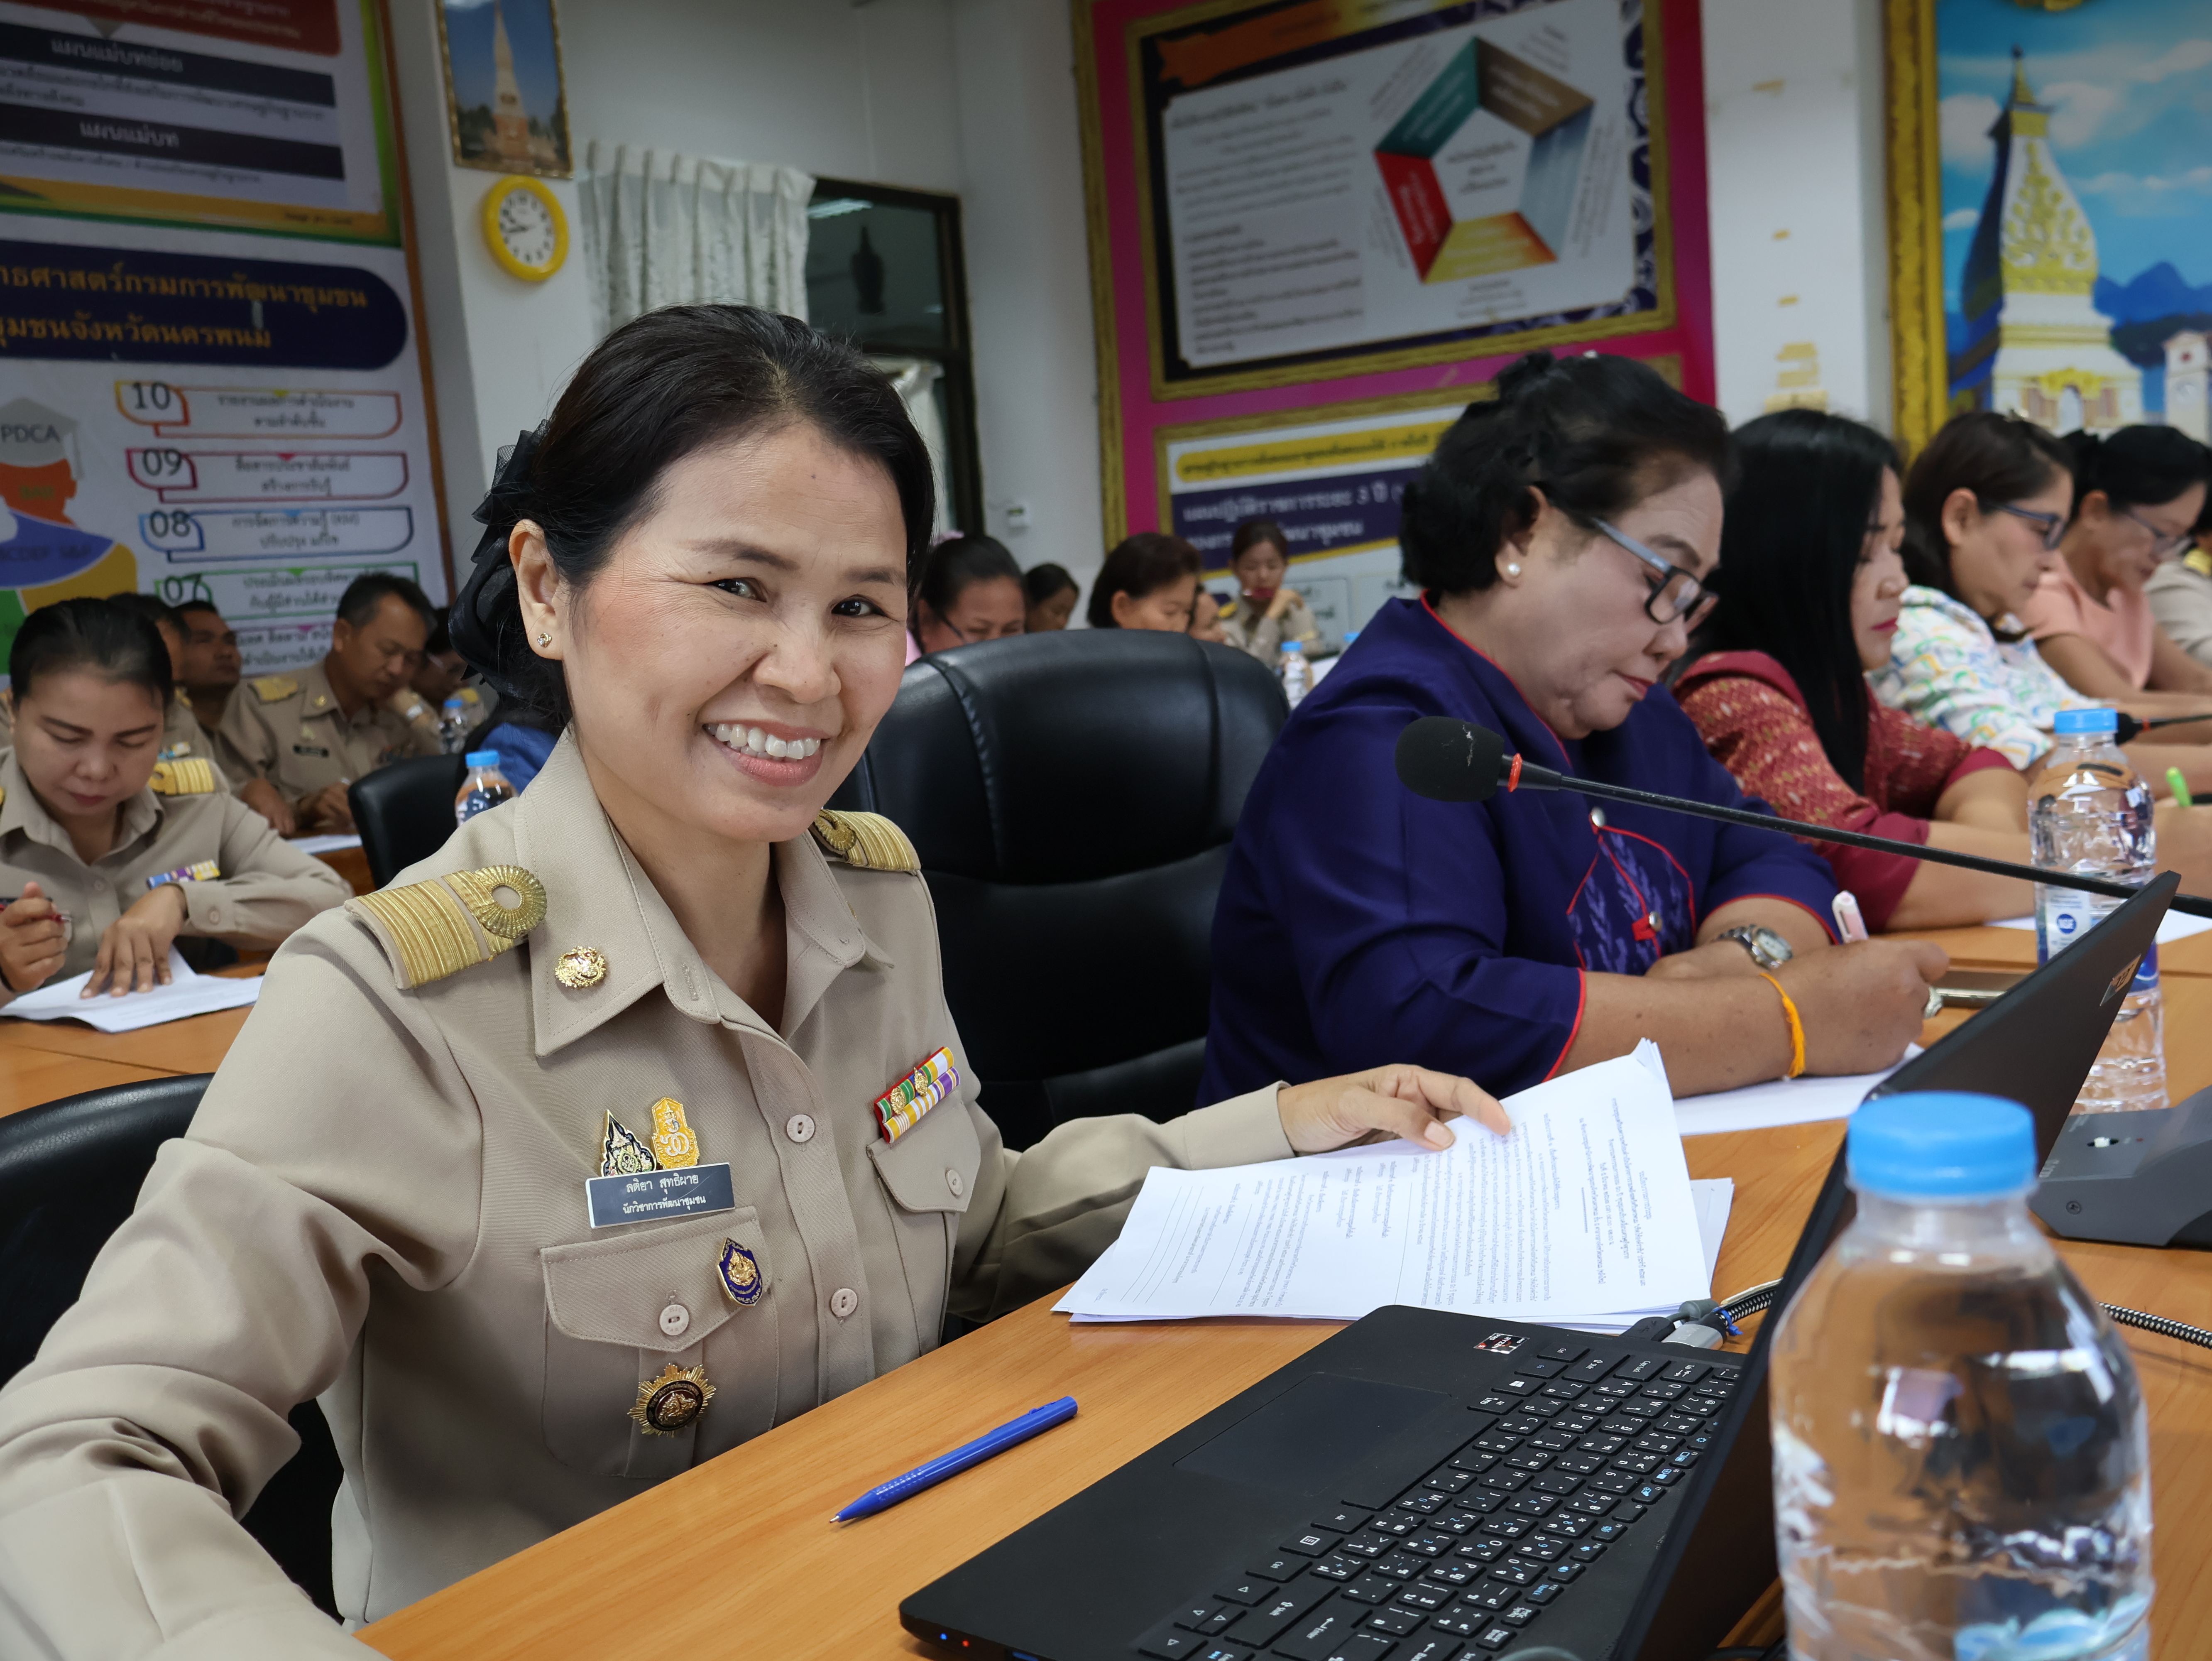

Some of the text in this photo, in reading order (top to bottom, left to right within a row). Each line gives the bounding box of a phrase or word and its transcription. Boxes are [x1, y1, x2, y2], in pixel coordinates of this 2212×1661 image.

[132, 382, 171, 411] 10
[1, 424, 60, 443] PDCA
[143, 447, 183, 476] 09
[149, 510, 190, 538] 08
[1491, 1337, 1512, 1349] RYZEN
